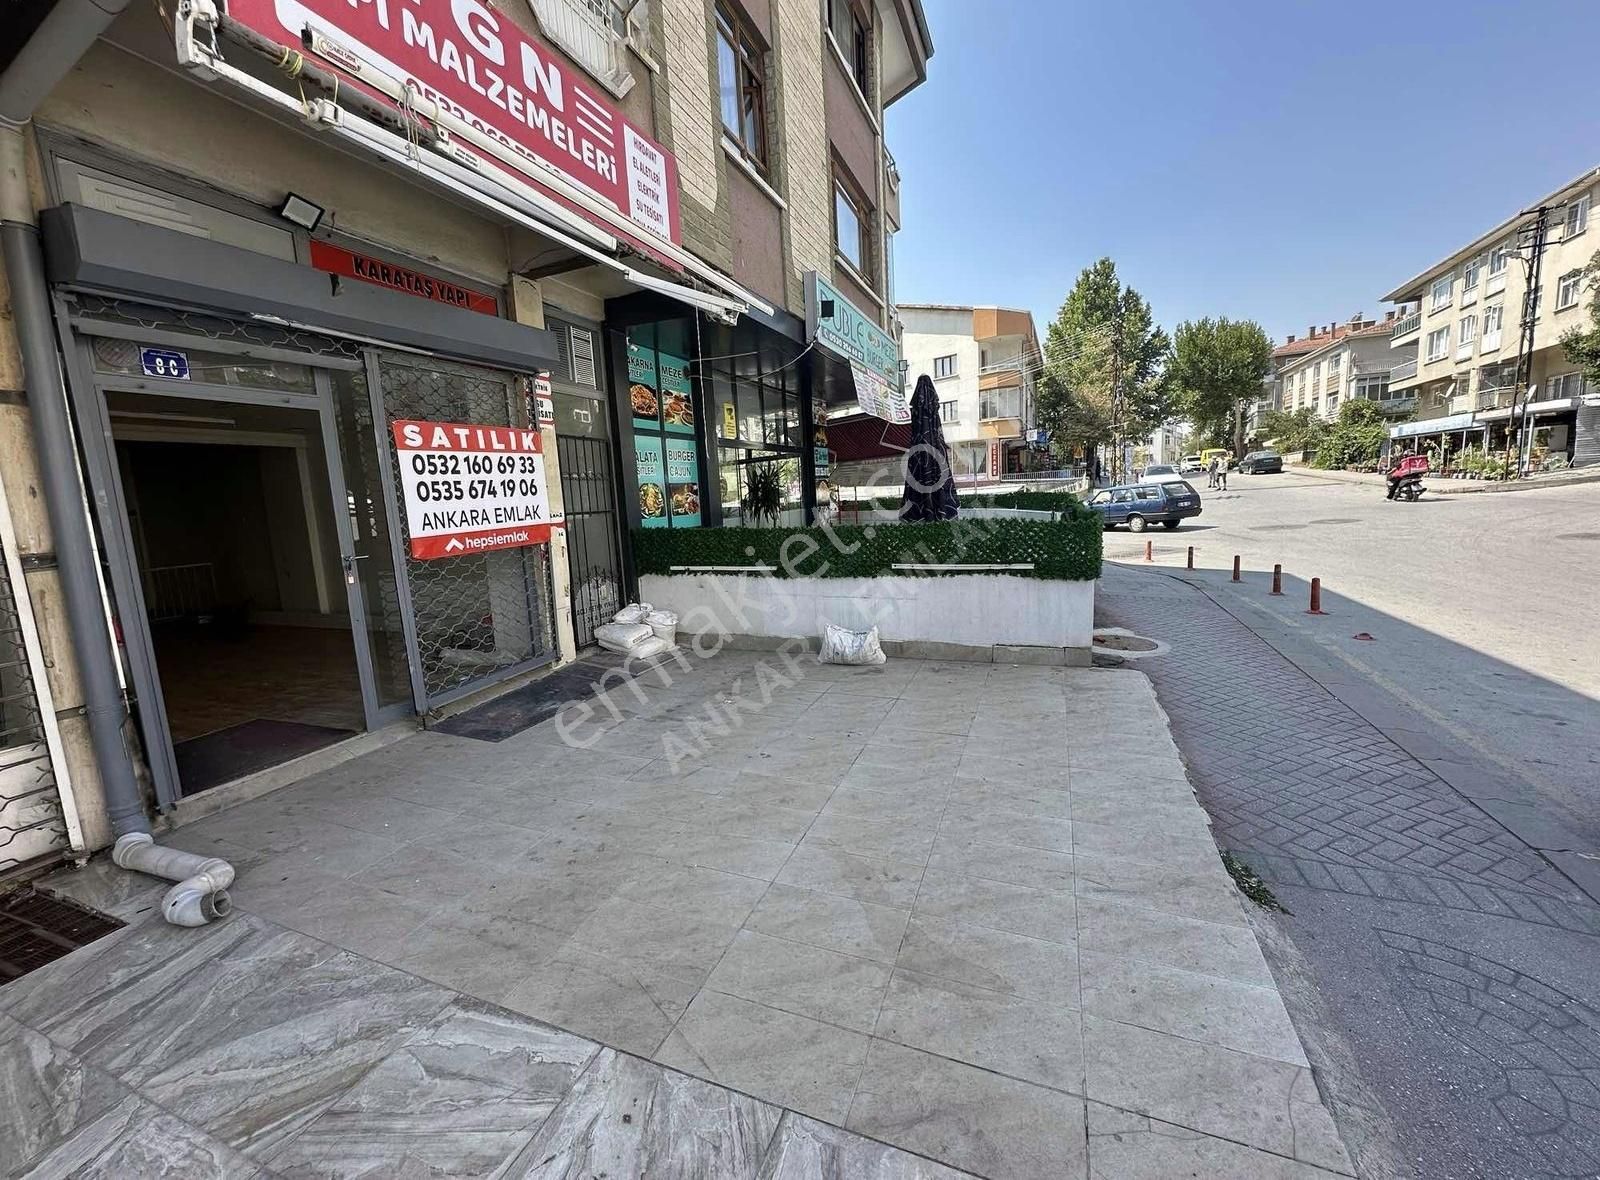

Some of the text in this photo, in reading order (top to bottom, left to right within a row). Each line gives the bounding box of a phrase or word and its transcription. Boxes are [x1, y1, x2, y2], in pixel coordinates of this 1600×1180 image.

[633, 136, 657, 165] HIRDAVAT
[632, 156, 661, 187] EL ALETLERİ
[637, 180, 660, 204] ELEKTRİK
[636, 198, 664, 226] SU TESİSATI
[352, 255, 472, 308] KARATAŞ YAPI
[661, 365, 682, 379] MEZE
[403, 424, 537, 451] SATILIK
[412, 454, 536, 475] 0532 160 69 33
[668, 450, 695, 462] BURGER
[669, 466, 691, 477] CAJUN
[416, 478, 538, 502] 0535 674 19 06
[422, 504, 542, 531] ANKARA EMLAK
[465, 530, 529, 551] hepsiemlak
